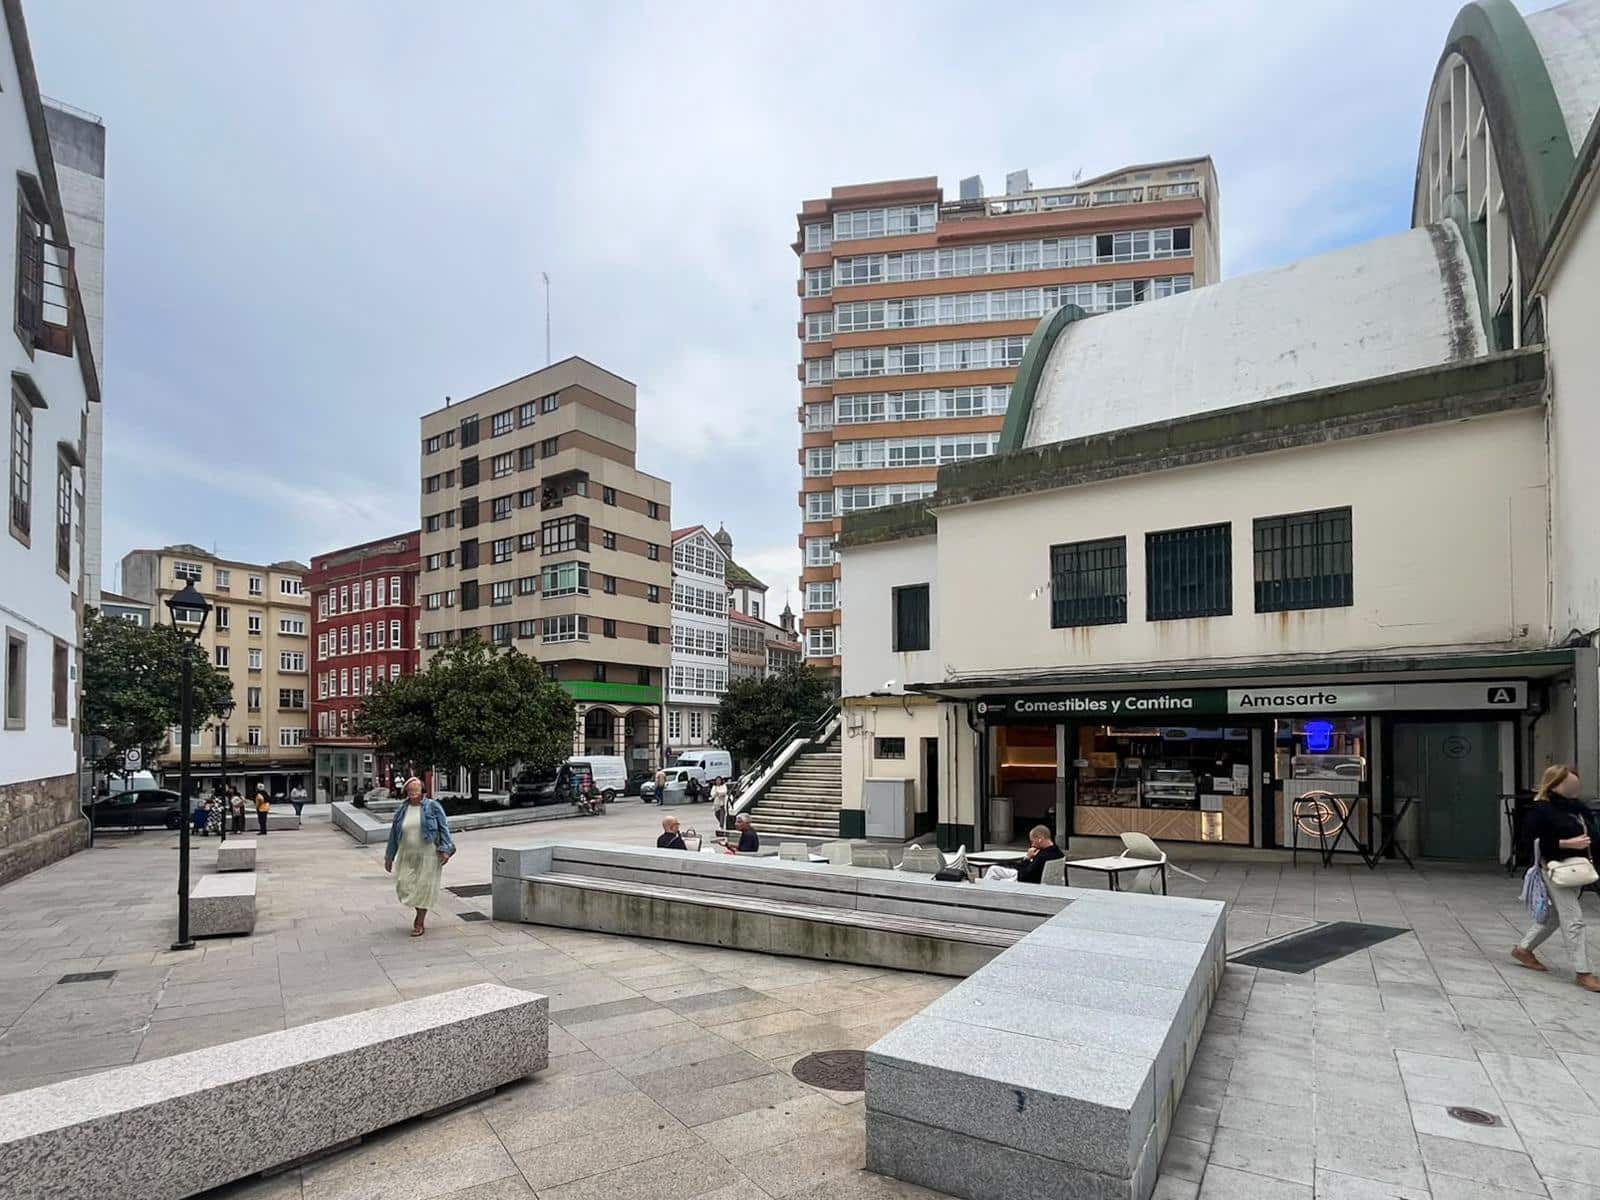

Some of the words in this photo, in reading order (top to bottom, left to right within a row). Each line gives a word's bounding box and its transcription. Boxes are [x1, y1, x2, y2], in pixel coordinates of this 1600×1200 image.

[1239, 691, 1337, 707] Amasarte
[1494, 688, 1511, 702] A
[1014, 697, 1107, 713] Comestibles
[1111, 699, 1121, 713] y
[1125, 695, 1193, 710] Cantina
